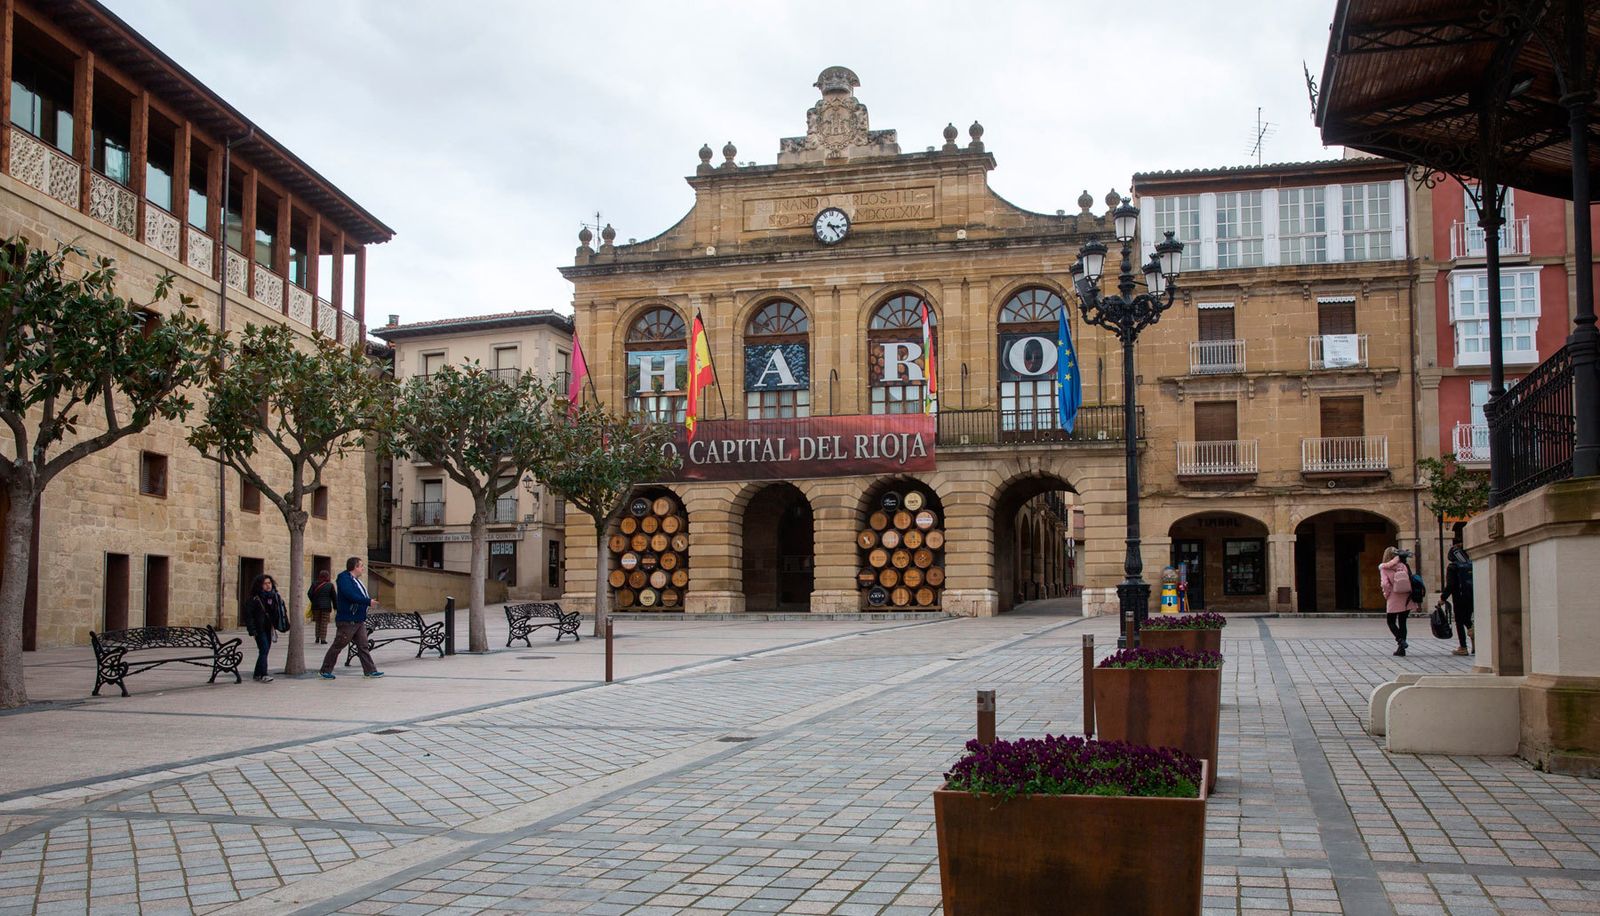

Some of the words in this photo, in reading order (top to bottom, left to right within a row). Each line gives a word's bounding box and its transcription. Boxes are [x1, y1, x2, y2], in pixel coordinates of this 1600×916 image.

[896, 191, 914, 203] III
[636, 353, 680, 393] H
[754, 348, 800, 387] A
[880, 342, 926, 382] R
[1009, 336, 1058, 376] O
[689, 437, 792, 465] CAPITAL
[798, 435, 848, 461] DEL
[854, 431, 928, 464] RIOJA
